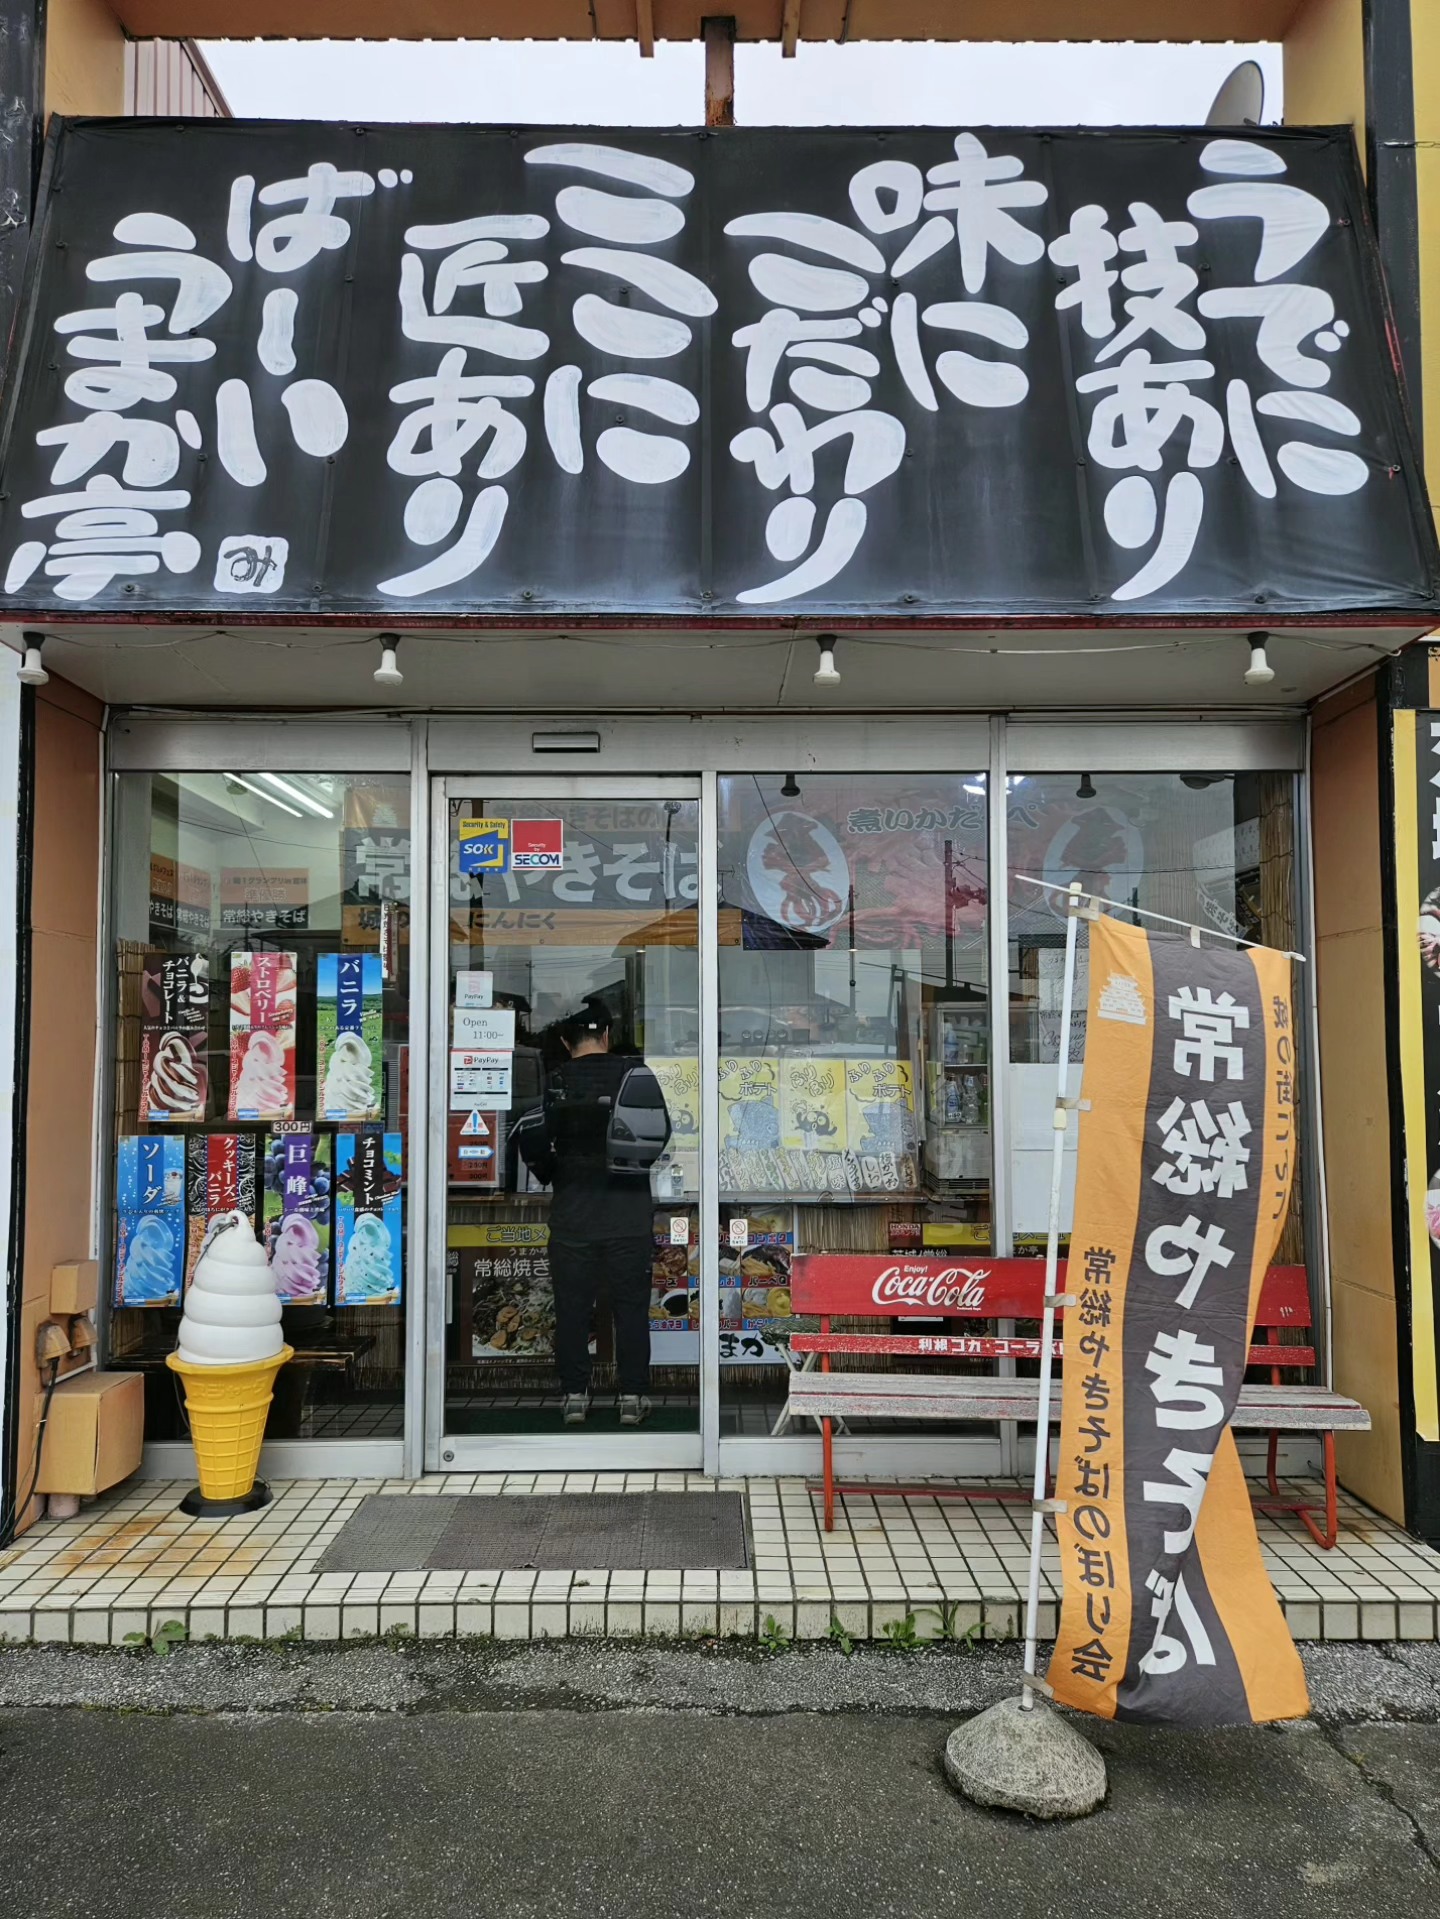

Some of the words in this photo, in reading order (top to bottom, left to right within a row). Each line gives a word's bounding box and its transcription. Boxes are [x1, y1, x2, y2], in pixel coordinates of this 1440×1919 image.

[848, 132, 1049, 411] 味に
[523, 142, 719, 484] ここに
[1187, 138, 1370, 500] うでに
[4, 211, 234, 601] うまか亭
[375, 213, 550, 598] 匠あり
[723, 211, 907, 604] こだわり
[1047, 201, 1224, 601] 技あり
[463, 821, 483, 829] Security
[490, 821, 506, 829] Safety
[848, 803, 1040, 834] 煮いかだぺ
[515, 854, 560, 865] SECOM
[223, 909, 307, 923] 常総やきそば
[162, 960, 176, 1024] チョコレート
[255, 956, 271, 1023] ストロベリー
[339, 960, 360, 1016] バニラ
[462, 1017, 488, 1028] Open
[474, 1056, 499, 1064] PayPay
[739, 1082, 777, 1096] ポテト
[872, 1083, 912, 1097] ポテト
[274, 1122, 311, 1132] 300円
[143, 1142, 165, 1205] ソーダ
[207, 1172, 222, 1206] バニラ
[222, 1137, 237, 1197] クッキーズ
[287, 1144, 308, 1196] 巨峰
[362, 1137, 376, 1205] チョコミント
[474, 1258, 551, 1278] 常総焼き
[903, 1264, 929, 1274] Enjoy!
